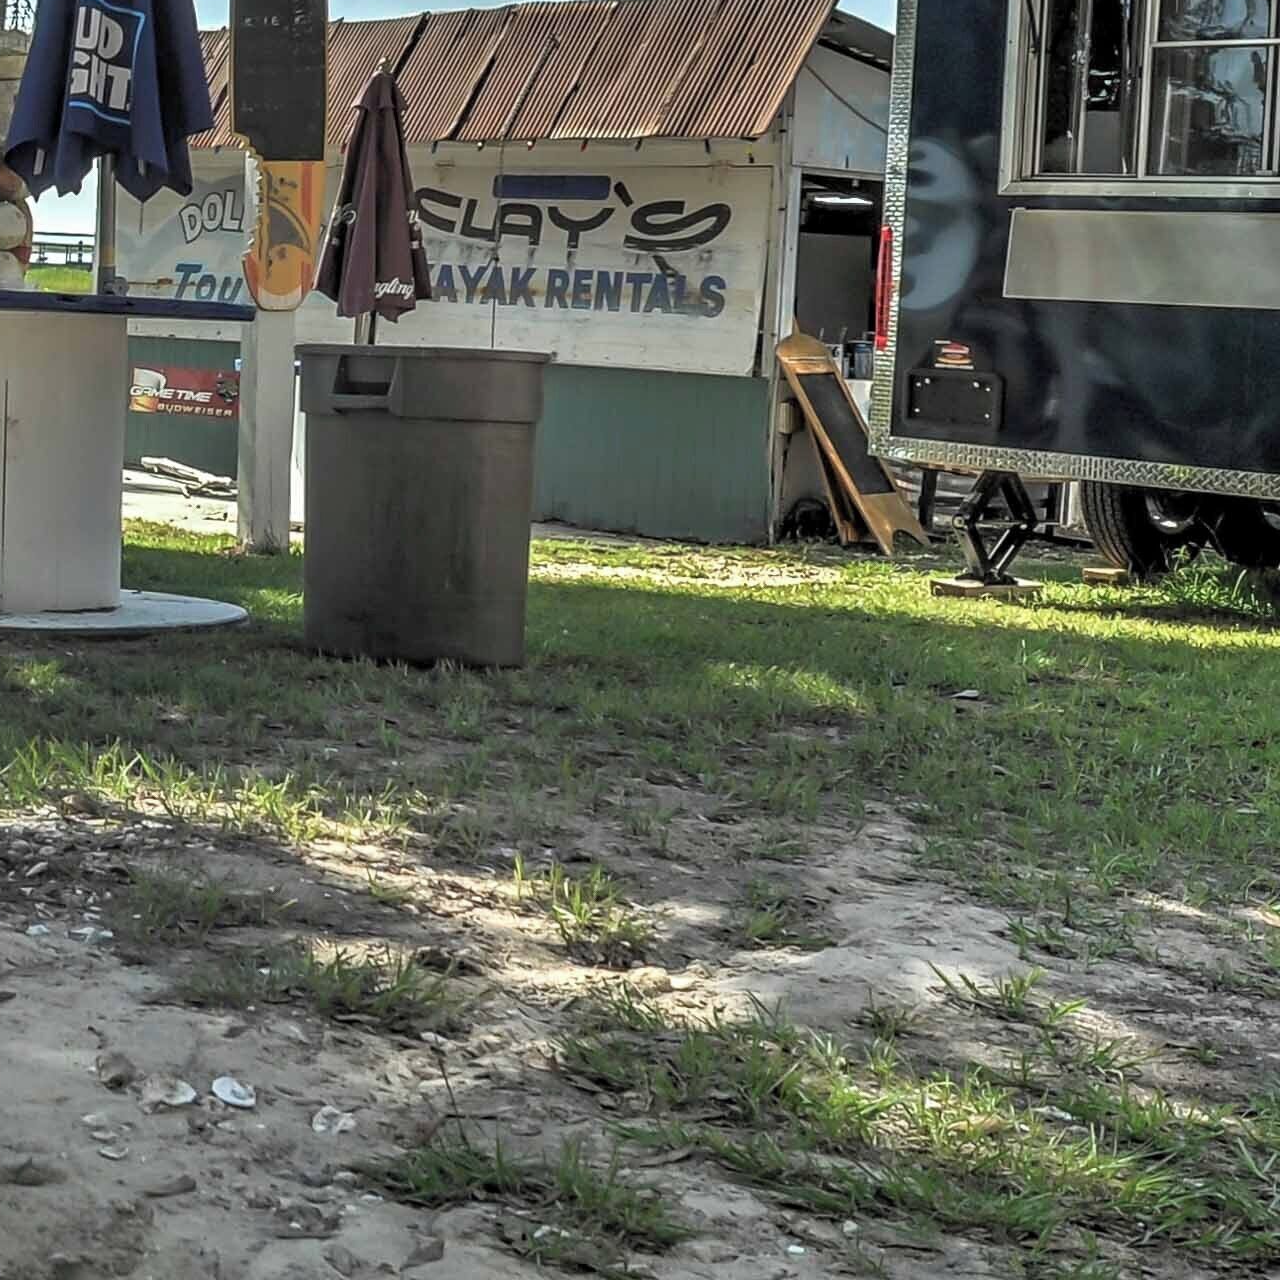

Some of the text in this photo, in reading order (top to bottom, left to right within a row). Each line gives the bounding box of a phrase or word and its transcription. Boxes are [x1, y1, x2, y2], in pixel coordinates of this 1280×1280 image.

[75, 6, 124, 60] UD
[179, 190, 244, 244] DOL
[414, 180, 732, 253] CLAY'S
[428, 263, 728, 319] AYAK RENTALS
[129, 385, 214, 403] GAME TIME
